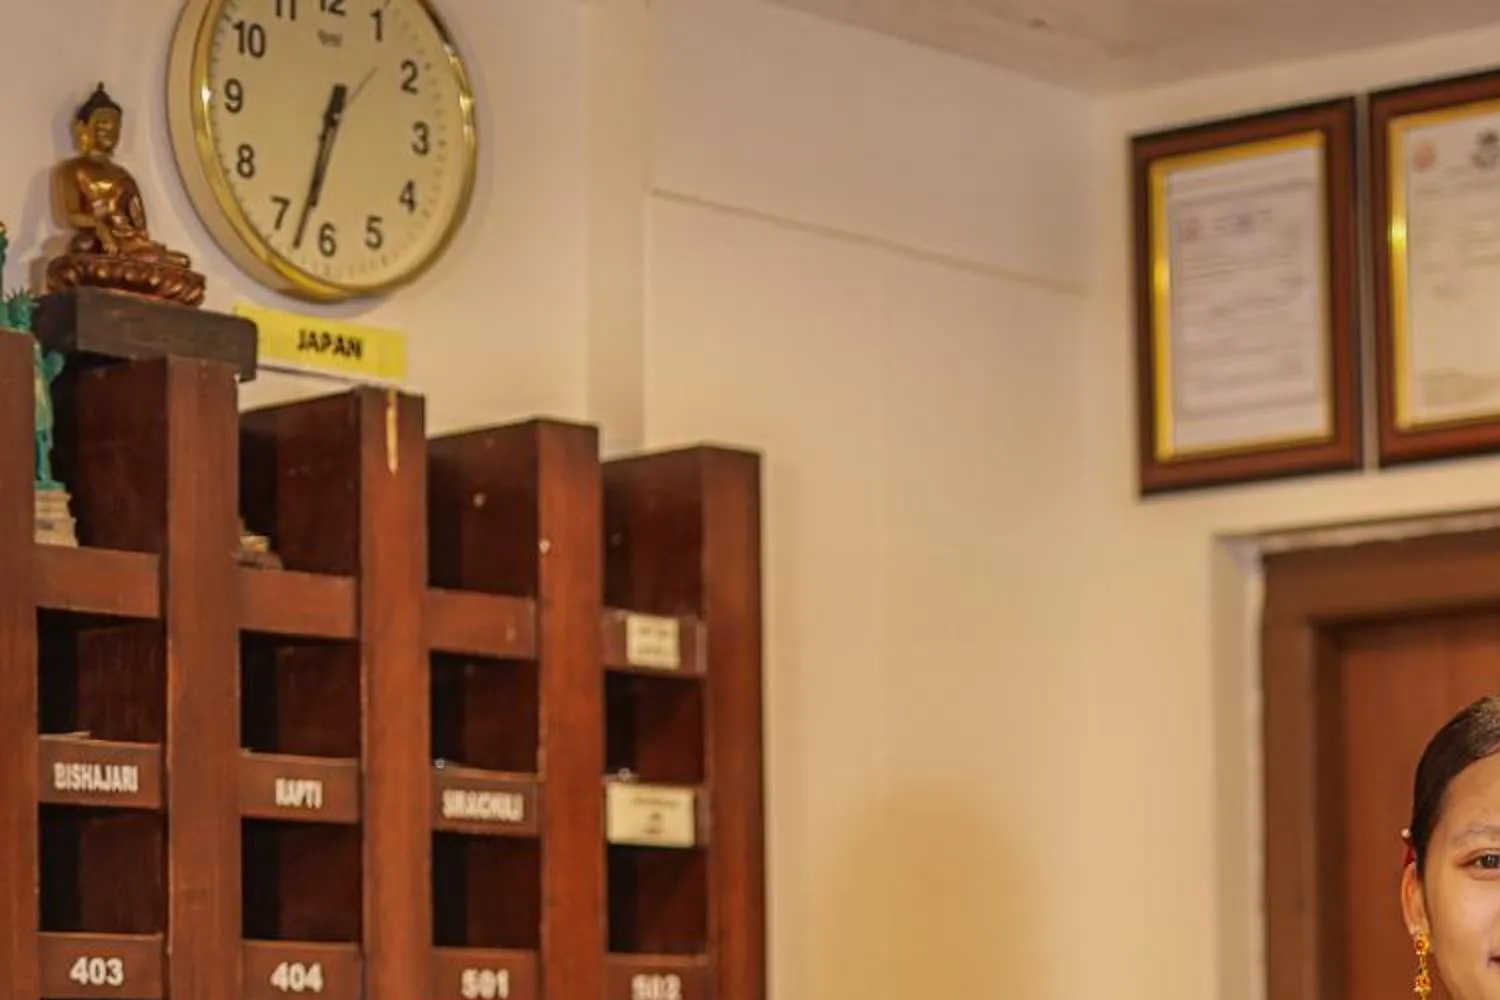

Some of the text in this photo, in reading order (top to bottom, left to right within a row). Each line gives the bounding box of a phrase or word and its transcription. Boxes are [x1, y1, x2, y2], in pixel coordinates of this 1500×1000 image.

[233, 20, 266, 59] 10
[370, 9, 383, 42] 1
[400, 60, 418, 95] 2
[224, 78, 244, 114] 9
[411, 121, 430, 156] 3
[236, 143, 256, 179] 8
[270, 195, 290, 231] 7
[399, 180, 416, 214] 4
[318, 222, 337, 257] 6
[364, 214, 384, 250] 5
[297, 329, 363, 359] JAPAN
[69, 957, 124, 986] 403
[270, 962, 323, 992] 404
